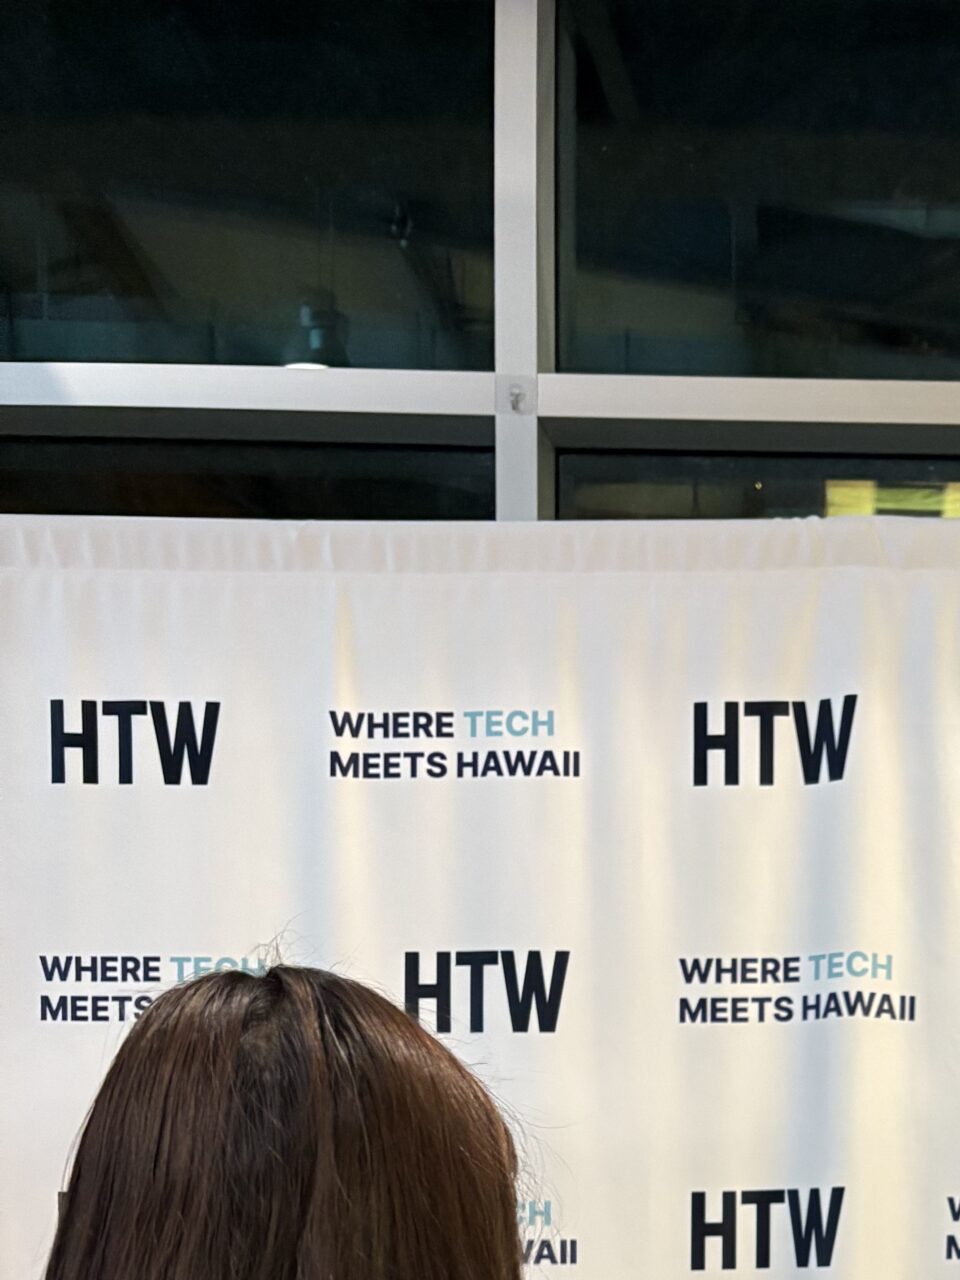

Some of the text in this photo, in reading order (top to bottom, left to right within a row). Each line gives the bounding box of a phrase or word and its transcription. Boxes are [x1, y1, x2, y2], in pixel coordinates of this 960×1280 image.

[329, 710, 556, 738] WHERE TECH
[693, 694, 858, 786] HTW
[50, 699, 221, 785] HTW
[329, 750, 581, 778] MEETS HAWAII
[39, 955, 161, 982] WHERE
[679, 951, 893, 984] WHERE TECH
[404, 950, 570, 1033] HTW
[679, 991, 916, 1024] MEETS HAWAII
[690, 1186, 845, 1271] HTW
